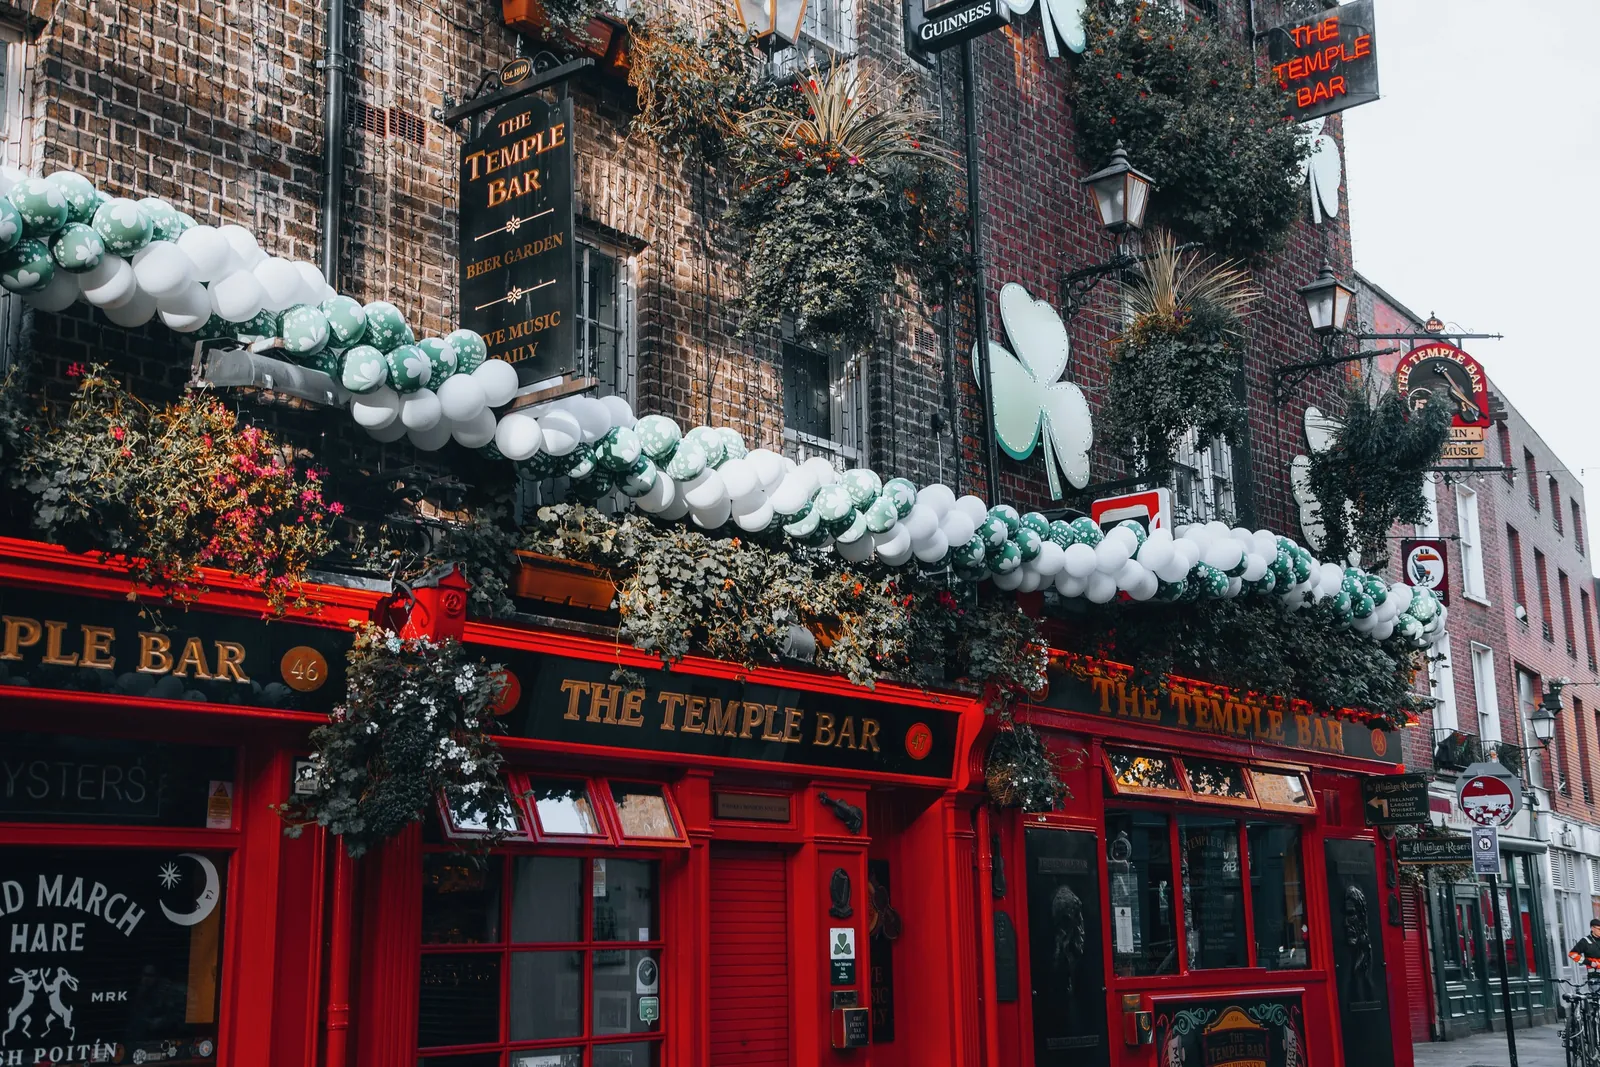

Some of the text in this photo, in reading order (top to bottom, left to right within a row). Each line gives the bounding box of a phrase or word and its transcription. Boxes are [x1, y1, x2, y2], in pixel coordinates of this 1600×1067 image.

[921, 1, 992, 40] GUINNESS
[1290, 16, 1339, 48] THE
[1272, 34, 1370, 80] TEMPLE
[1297, 75, 1346, 107] BAR
[498, 111, 532, 137] THE
[464, 122, 566, 183] TEMPLE
[487, 168, 542, 208] BAR
[466, 232, 564, 280] BEER GARDEN
[509, 310, 561, 340] MUSIC
[1398, 347, 1482, 394] THE TEMPLE BAR
[1443, 446, 1479, 456] MUSIC
[0, 615, 251, 684] PLE BAR
[290, 659, 320, 682] 46
[560, 678, 881, 752] THE TEMPLE BAR
[1091, 677, 1344, 751] THE TEMPLE BAR
[911, 731, 928, 751] 47
[3, 761, 147, 803] YSTERS
[1400, 781, 1424, 792] Reserve
[0, 874, 146, 937] D MARCH
[10, 922, 85, 953] HARE
[91, 991, 128, 1002] MRK
[34, 1039, 118, 1064] POITÍN
[1209, 1043, 1245, 1063] TEMPLE
[1246, 1043, 1266, 1057] BAR
[1228, 1032, 1245, 1043] THE
